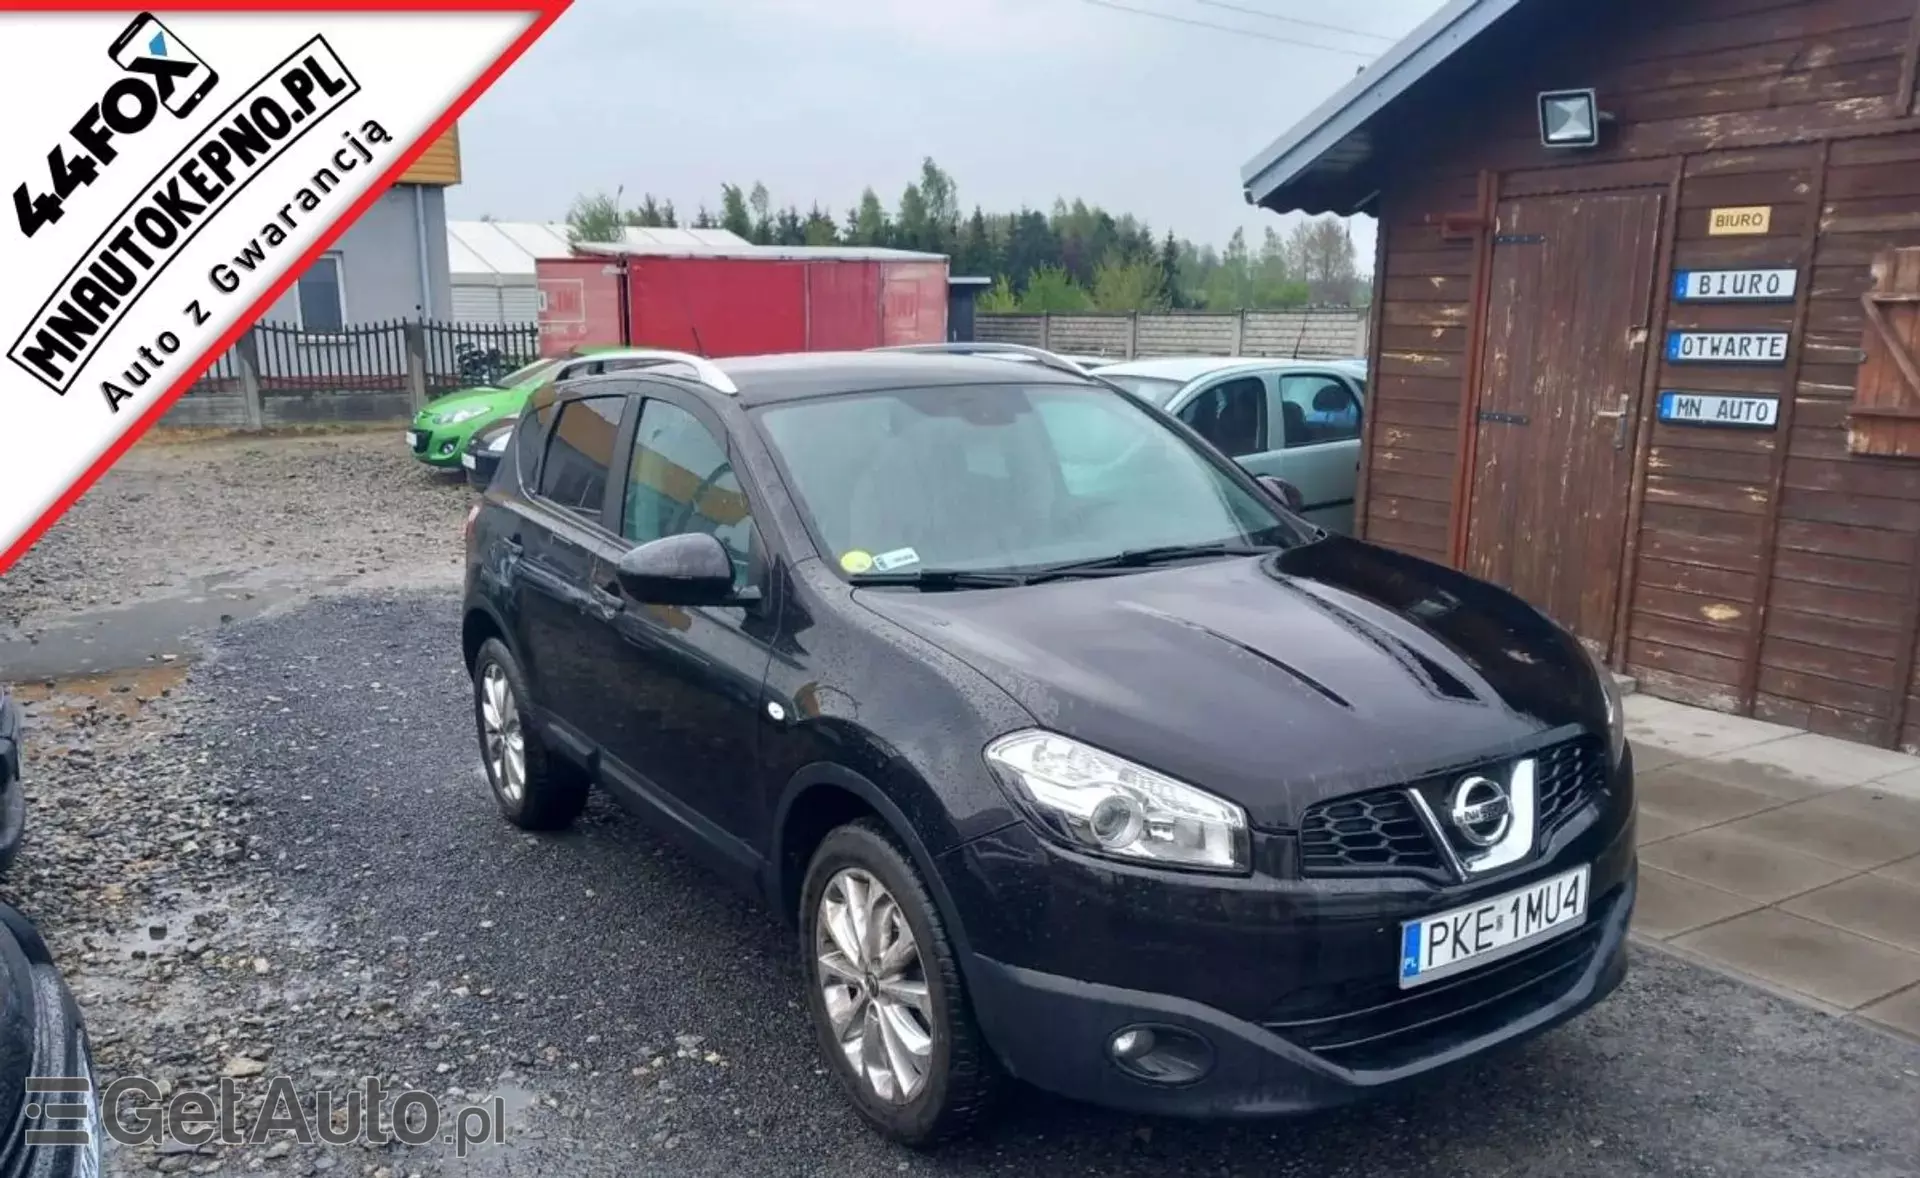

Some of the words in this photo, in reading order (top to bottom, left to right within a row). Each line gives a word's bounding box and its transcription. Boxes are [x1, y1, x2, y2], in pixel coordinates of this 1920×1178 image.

[1714, 213, 1764, 228] BIURO
[1698, 273, 1781, 296] BIURO
[1682, 335, 1783, 357] OTWARTE
[1676, 399, 1702, 418] MN
[1716, 400, 1769, 421] AUTO
[1427, 905, 1496, 967] PKE
[1510, 874, 1580, 938] 1MU4
